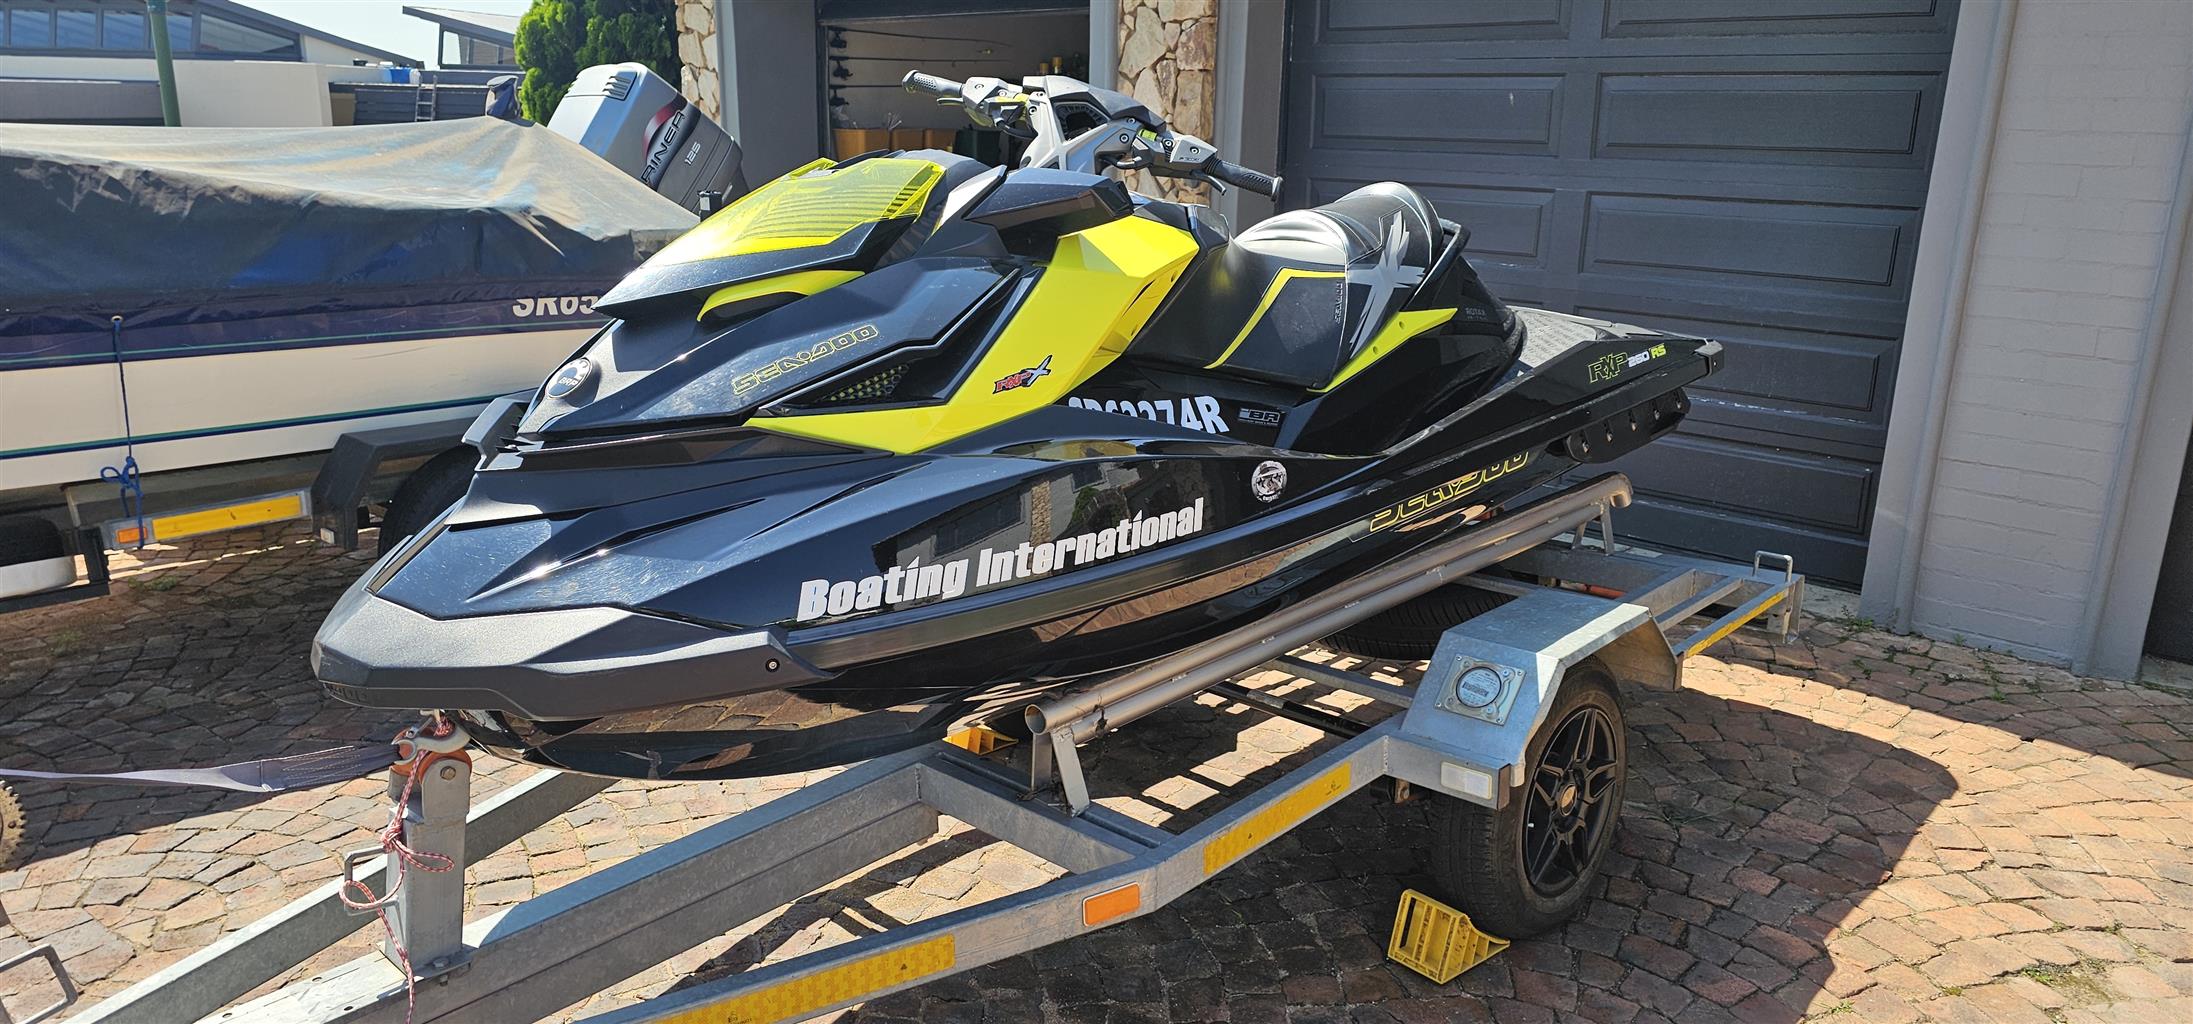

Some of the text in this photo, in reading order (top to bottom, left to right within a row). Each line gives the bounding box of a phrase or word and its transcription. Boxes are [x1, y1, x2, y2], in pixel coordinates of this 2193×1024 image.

[684, 142, 701, 166] 125
[1587, 352, 1629, 384] RXP
[797, 496, 1204, 622] Boating International
